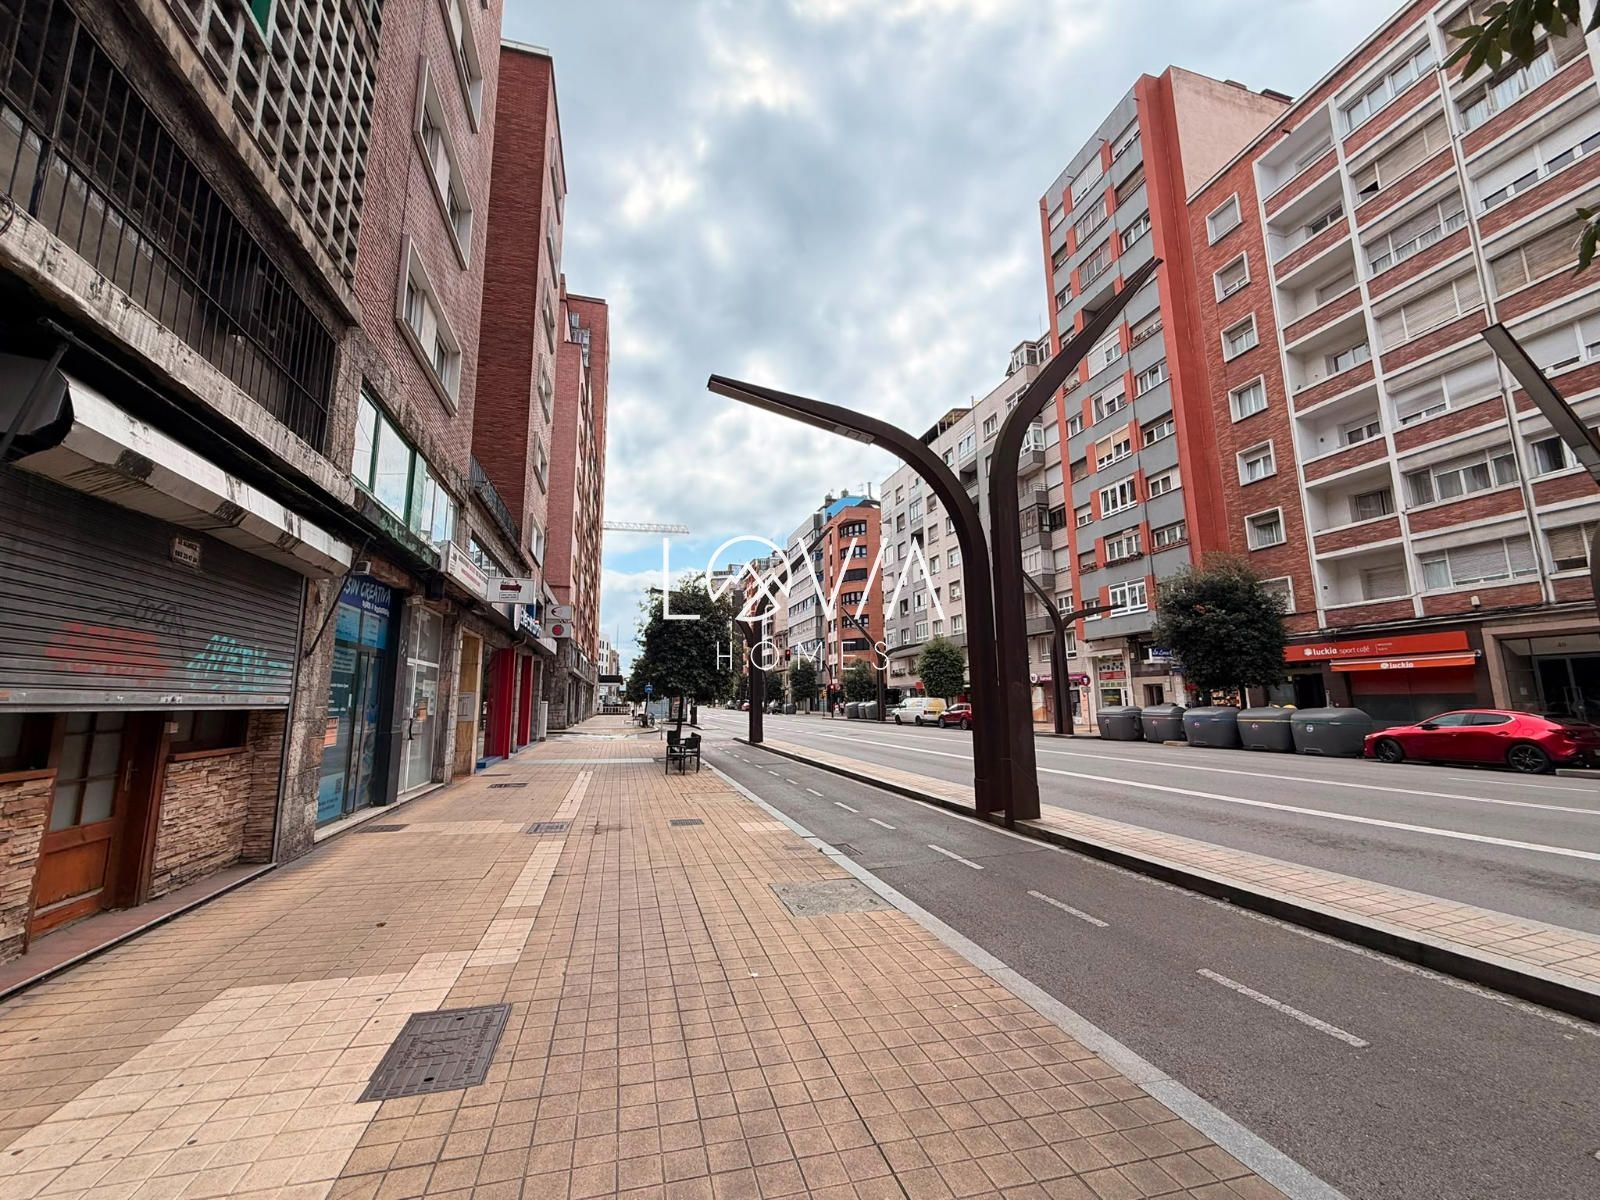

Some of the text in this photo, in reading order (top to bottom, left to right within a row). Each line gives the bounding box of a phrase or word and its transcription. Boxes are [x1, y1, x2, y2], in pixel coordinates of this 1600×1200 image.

[1313, 646, 1338, 656] luckia
[1339, 647, 1357, 655] sport
[1356, 645, 1370, 653] café
[1389, 661, 1414, 669] luckia
